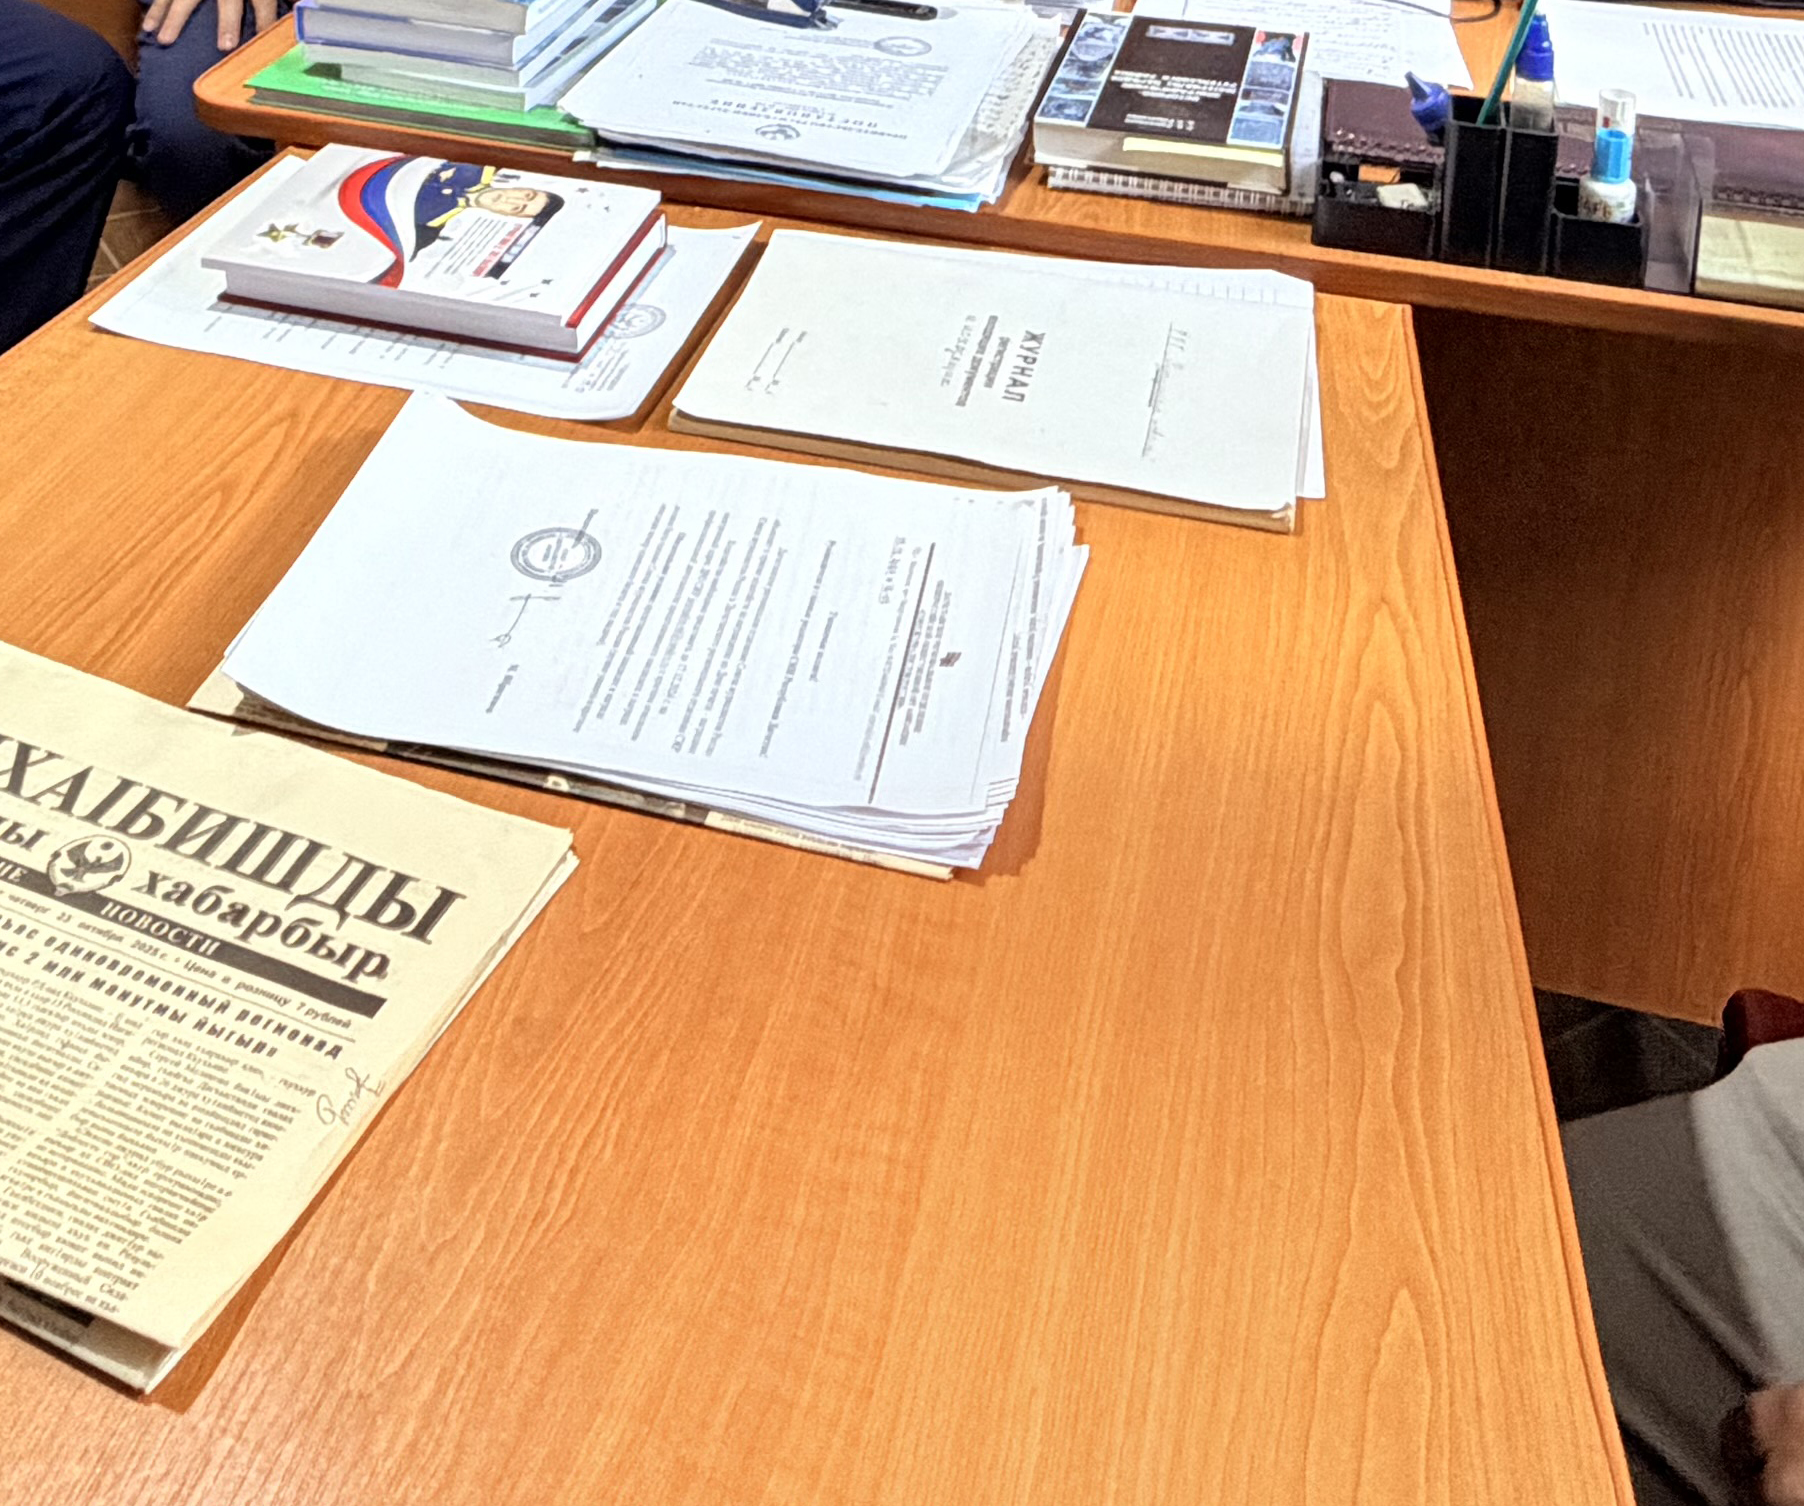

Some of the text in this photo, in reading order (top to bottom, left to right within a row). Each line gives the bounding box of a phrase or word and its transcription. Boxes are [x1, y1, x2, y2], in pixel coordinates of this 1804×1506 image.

[1003, 330, 1045, 402] ЖУРНАЛ
[100, 900, 223, 957] НОВОСТИ
[130, 869, 392, 985] хабарбыр
[23, 951, 40, 965] 2
[183, 959, 216, 978] Цена
